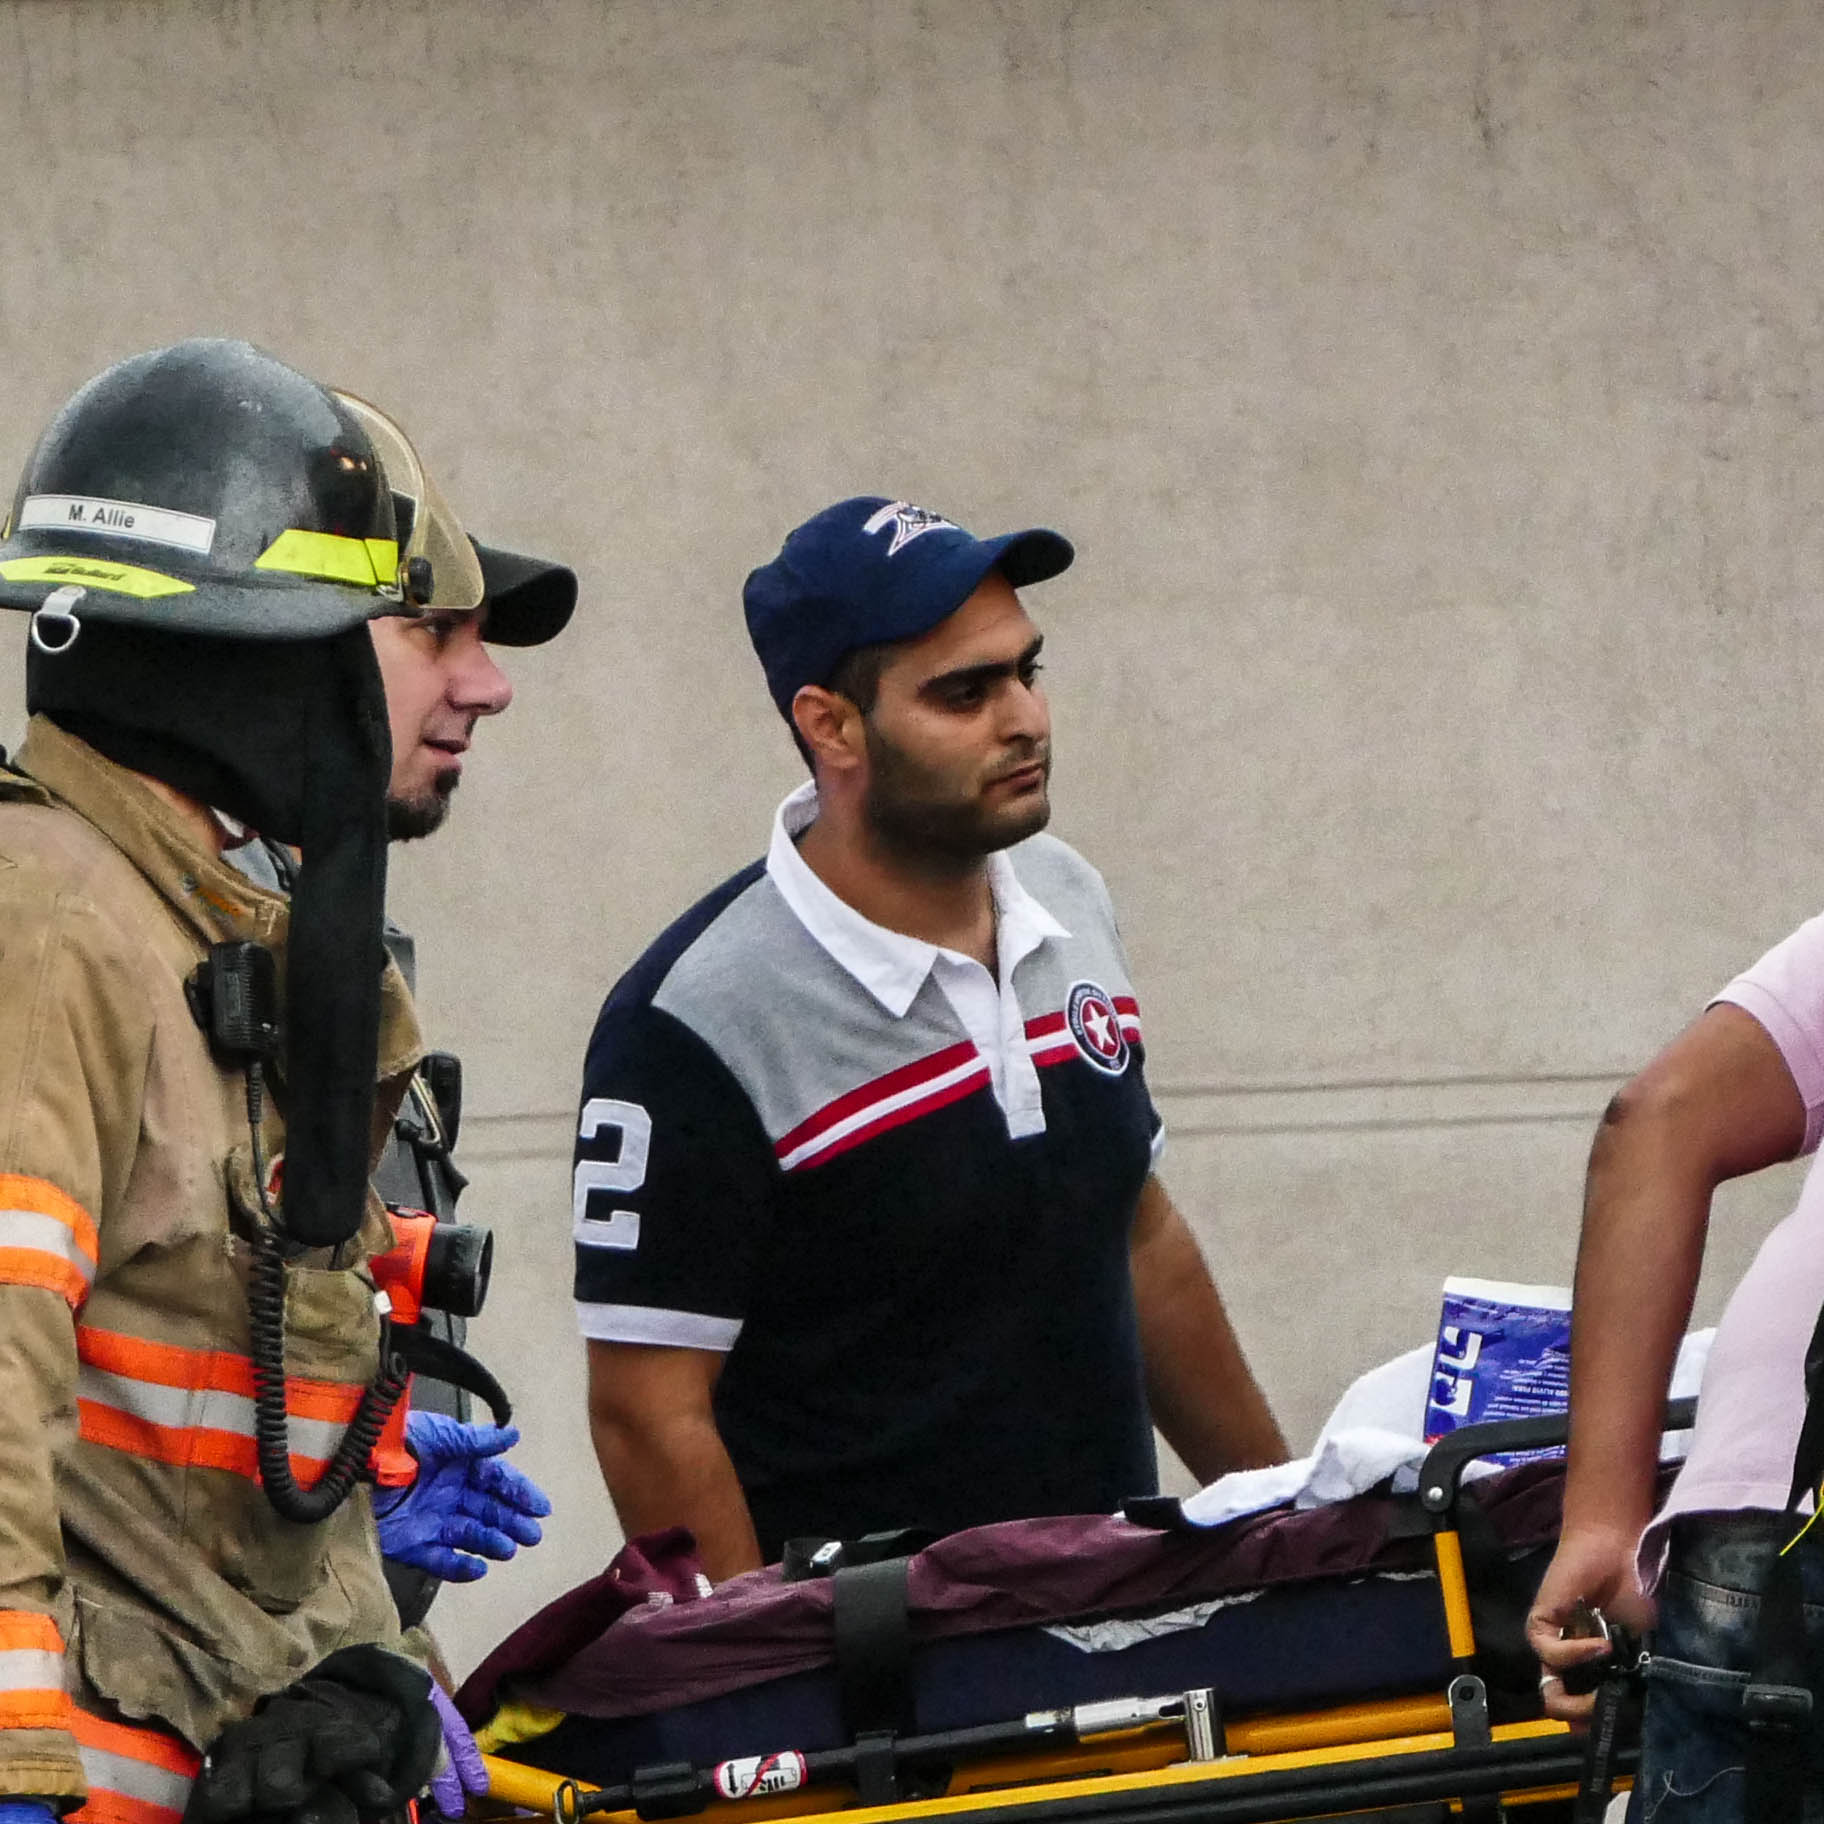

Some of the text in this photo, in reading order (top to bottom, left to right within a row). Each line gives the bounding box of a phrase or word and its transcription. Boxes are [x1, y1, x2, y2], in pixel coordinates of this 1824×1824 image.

[68, 504, 135, 528] M. Allie
[574, 1099, 652, 1250] 2
